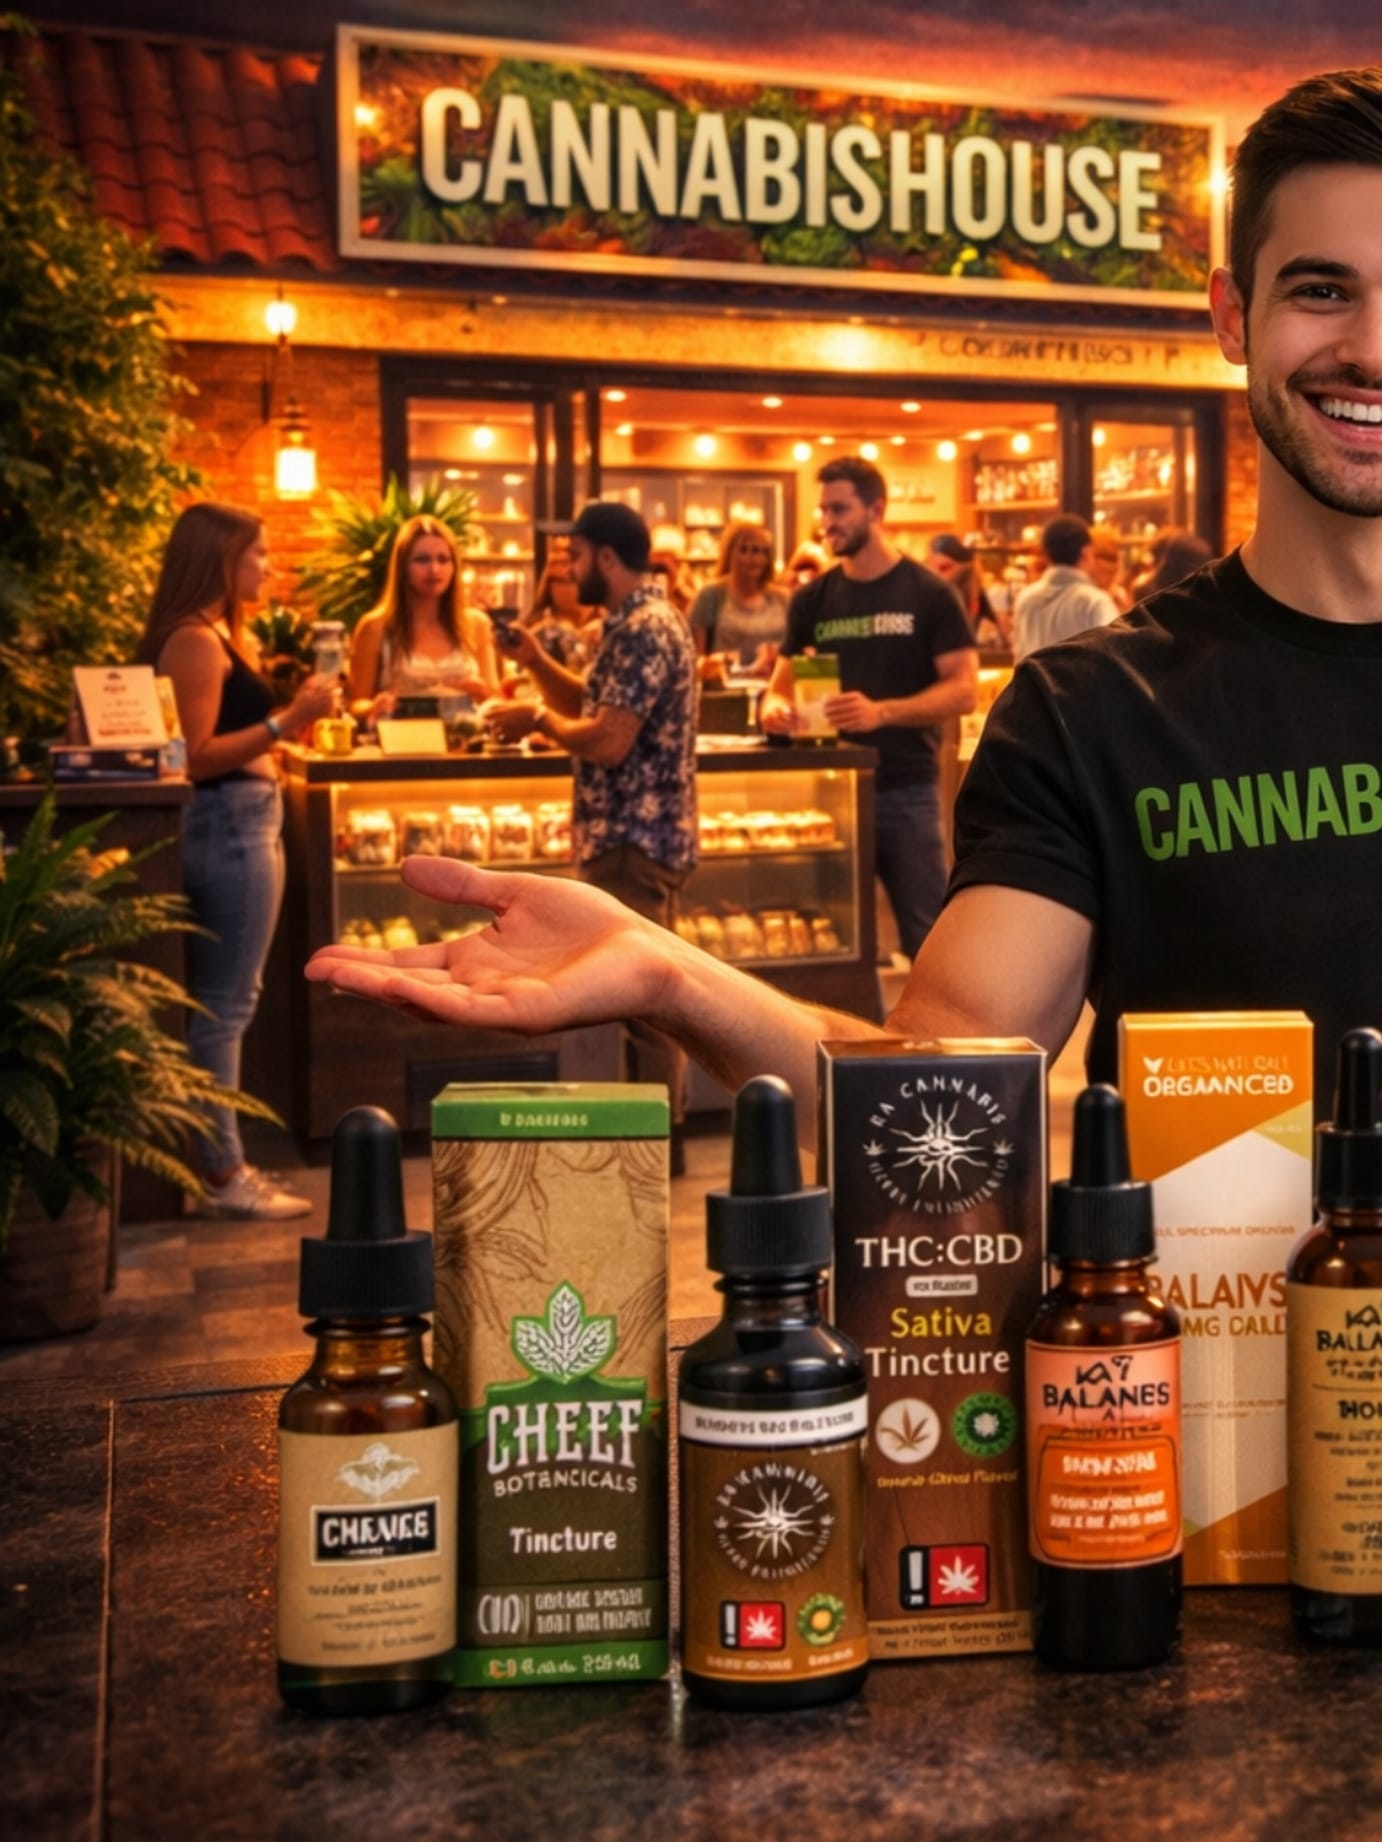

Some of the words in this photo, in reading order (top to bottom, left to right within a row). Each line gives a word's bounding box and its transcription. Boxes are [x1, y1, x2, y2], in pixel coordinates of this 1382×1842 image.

[419, 86, 1163, 252] CANNABISHOUSE
[855, 1233, 1023, 1268] THC:CBD
[890, 1306, 992, 1339] Sativa
[864, 1347, 1010, 1378] Tincture
[486, 1399, 643, 1475] CHEEF
[509, 1526, 617, 1554] Tincture
